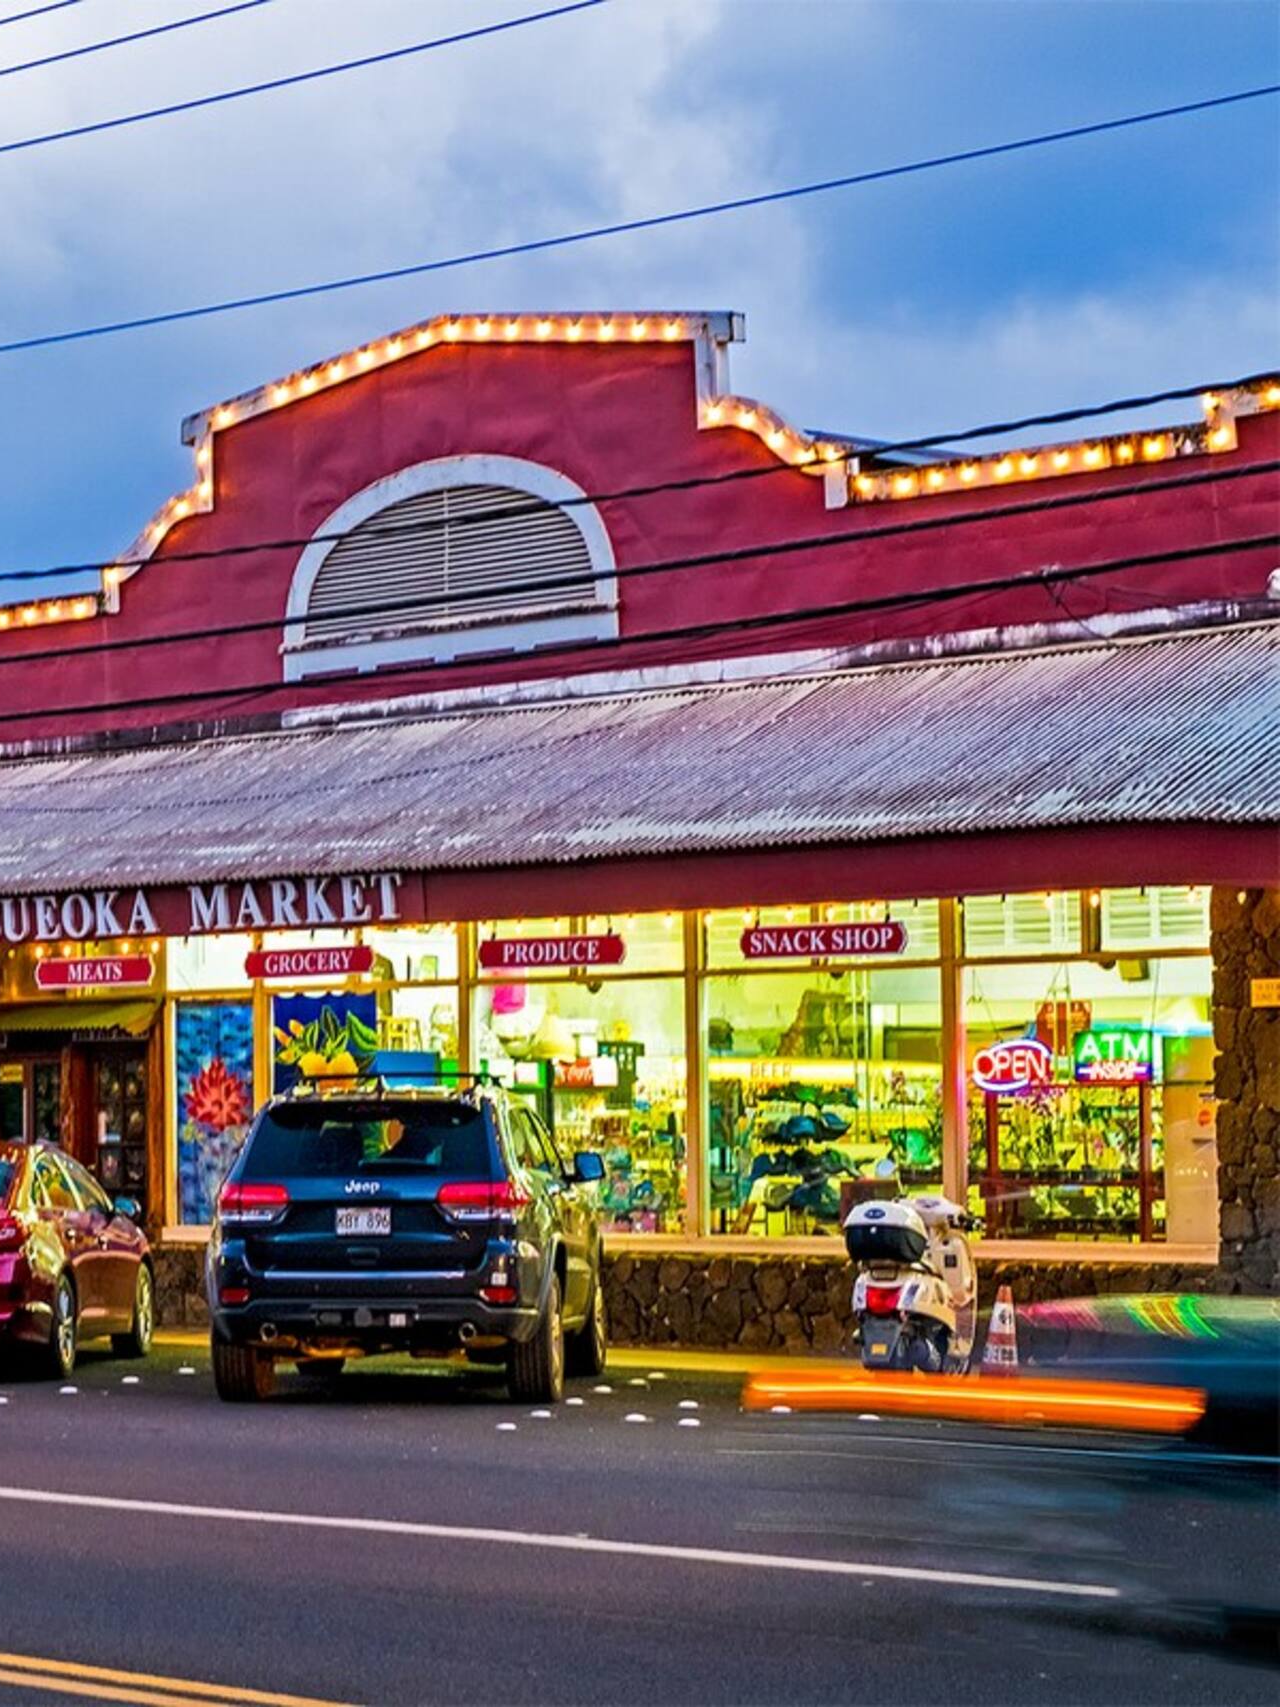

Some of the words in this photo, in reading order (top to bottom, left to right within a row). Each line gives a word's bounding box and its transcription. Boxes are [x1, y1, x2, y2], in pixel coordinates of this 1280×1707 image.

[188, 872, 404, 932] MARKET
[501, 940, 600, 964] PRODUCE
[748, 930, 827, 955] SNACK
[831, 927, 893, 951] SHOP
[66, 959, 123, 983] MEATS
[263, 949, 354, 975] GROCERY
[1078, 1033, 1150, 1063] ATM
[749, 1061, 793, 1078] BEER
[973, 1049, 1047, 1081] OPEN
[344, 1179, 381, 1195] Jeep
[338, 1214, 361, 1230] KBY
